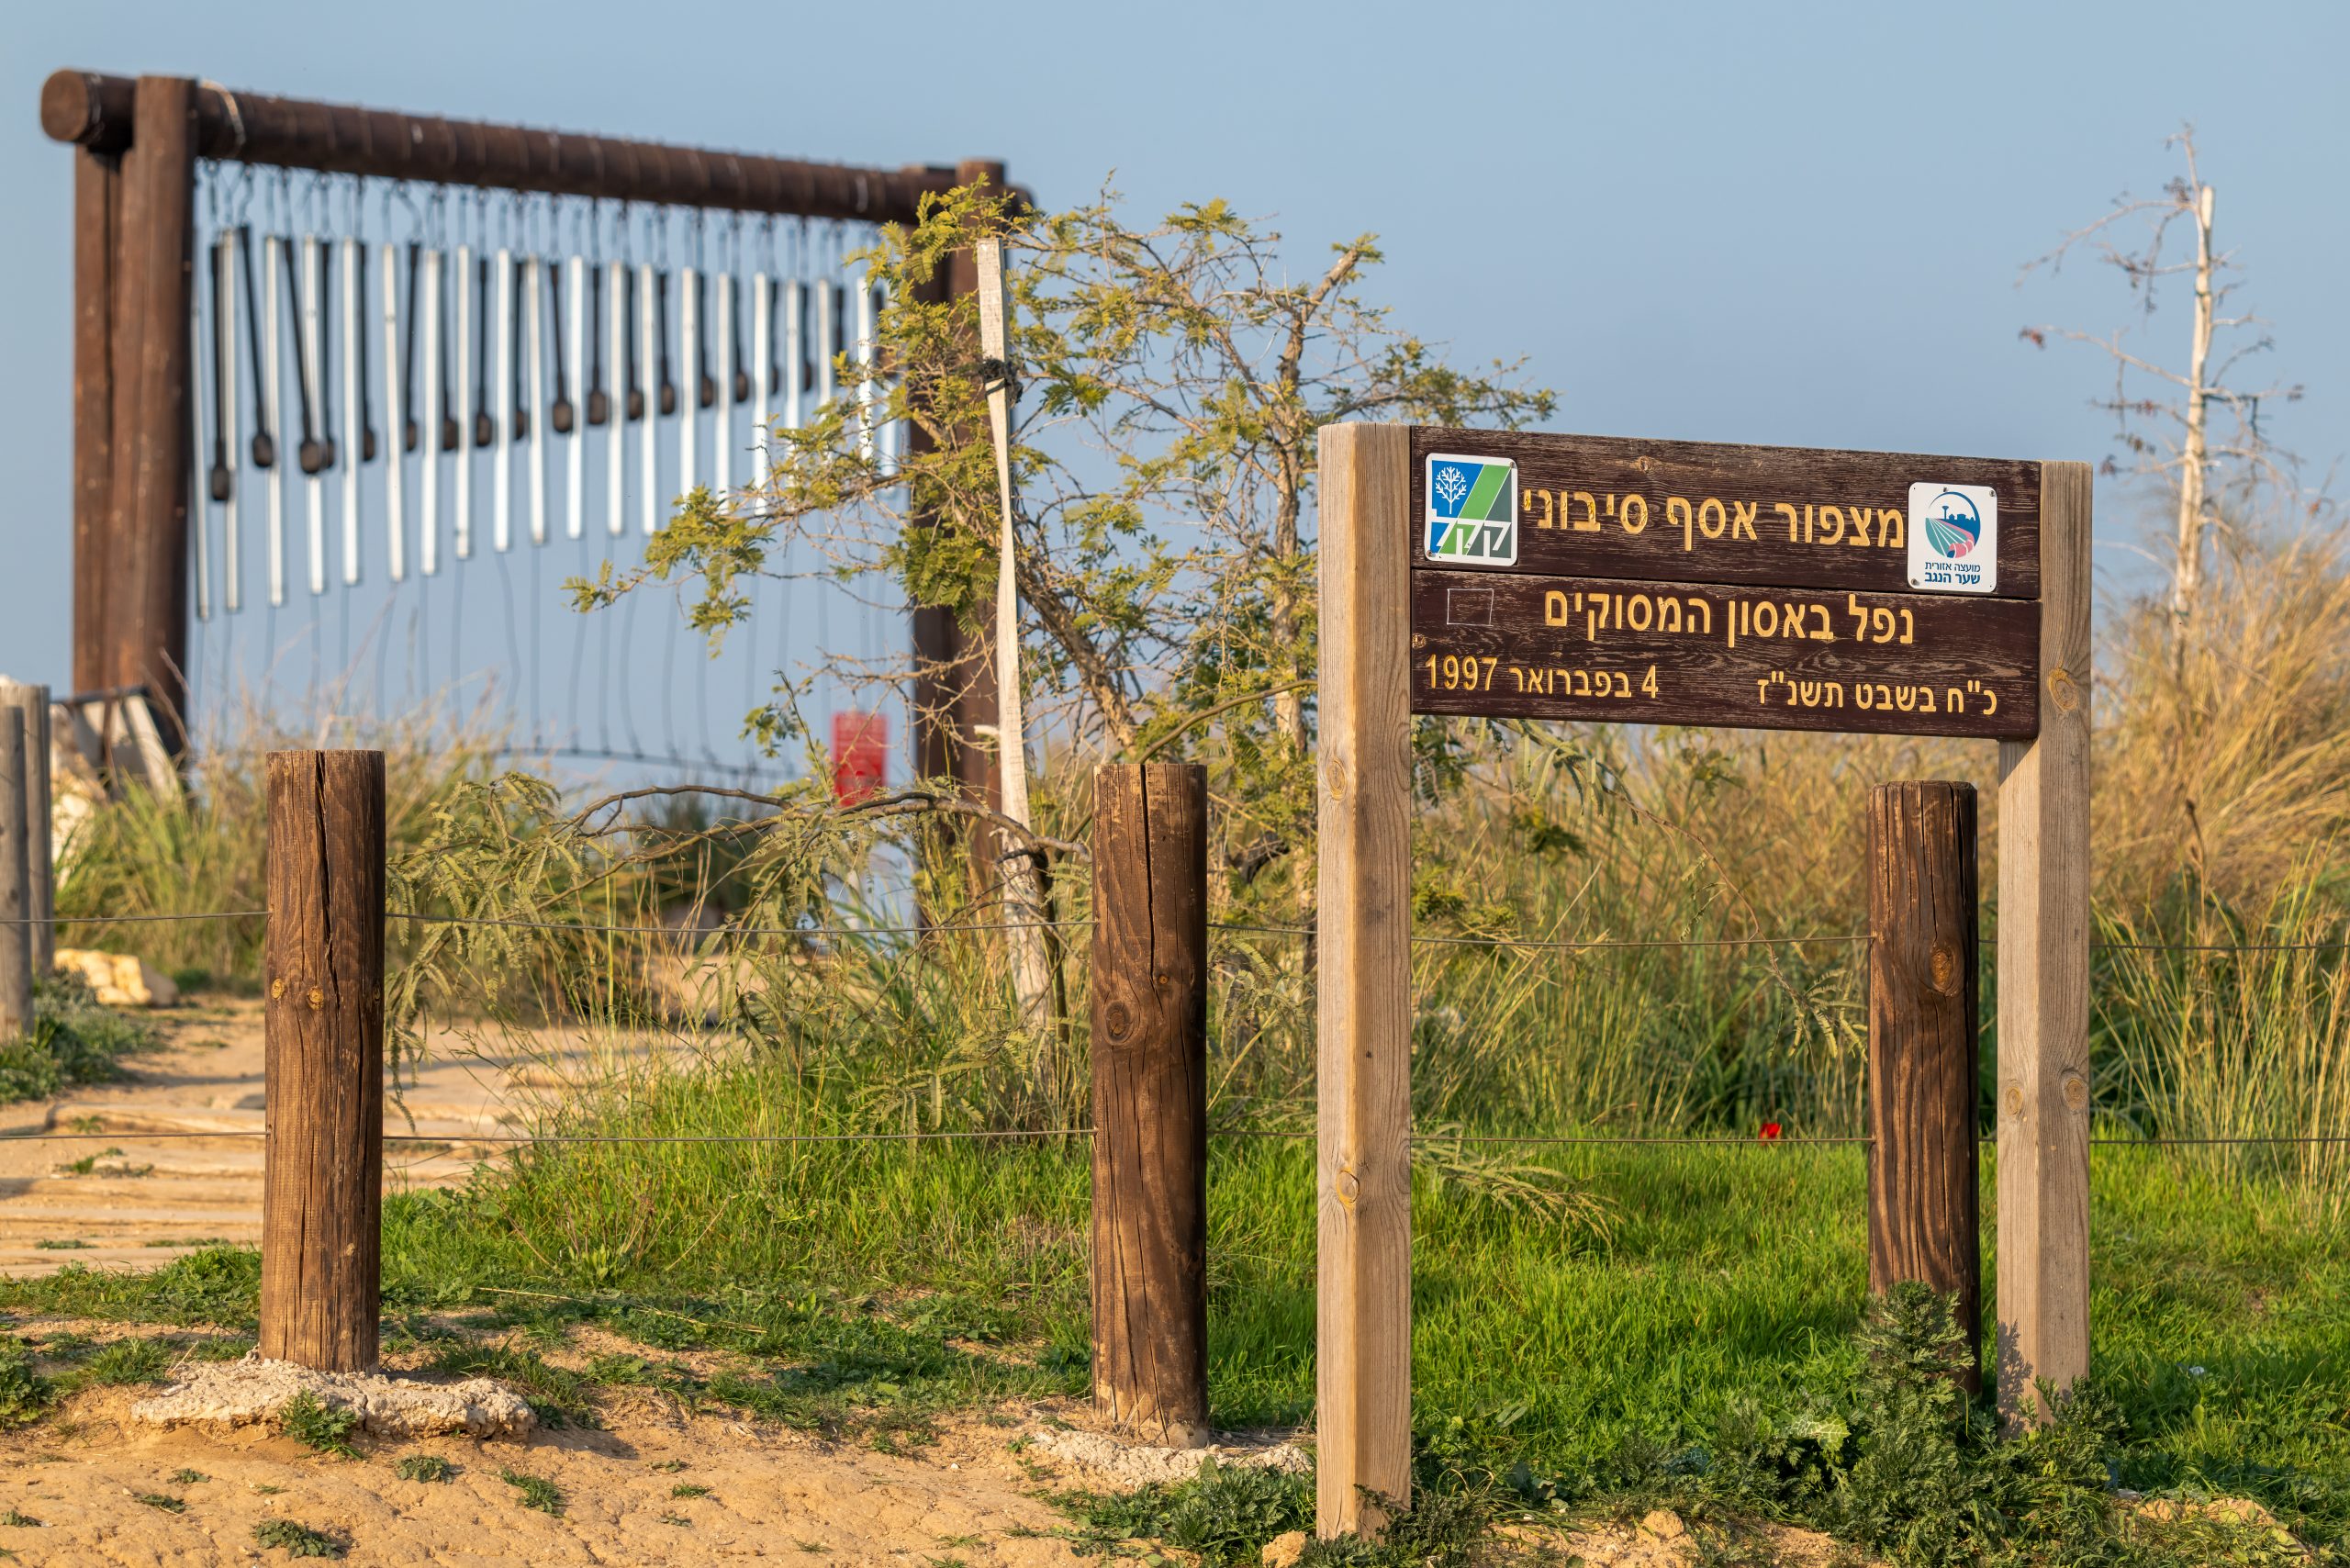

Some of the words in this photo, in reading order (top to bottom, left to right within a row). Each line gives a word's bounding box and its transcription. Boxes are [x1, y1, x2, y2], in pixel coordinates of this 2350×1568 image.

[1523, 488, 1649, 535] סיבוני
[1666, 497, 1758, 552] אסף
[1774, 502, 1905, 550] מצפור
[1924, 561, 1952, 571] אזורית
[1924, 571, 1952, 584] הנגב
[1953, 562, 1981, 573] מועצה
[1954, 573, 1981, 585] שער
[1544, 590, 1711, 642] המסוקים
[1728, 599, 1834, 648] באסון
[1848, 593, 1915, 644] נפל
[1425, 653, 1498, 693] 1997
[1508, 666, 1632, 699] בפברואר
[1641, 665, 1659, 699] 4
[1757, 670, 1844, 709] תשנ"ז
[1855, 683, 1938, 713] בשבט
[1947, 679, 1998, 716] כ"ח
